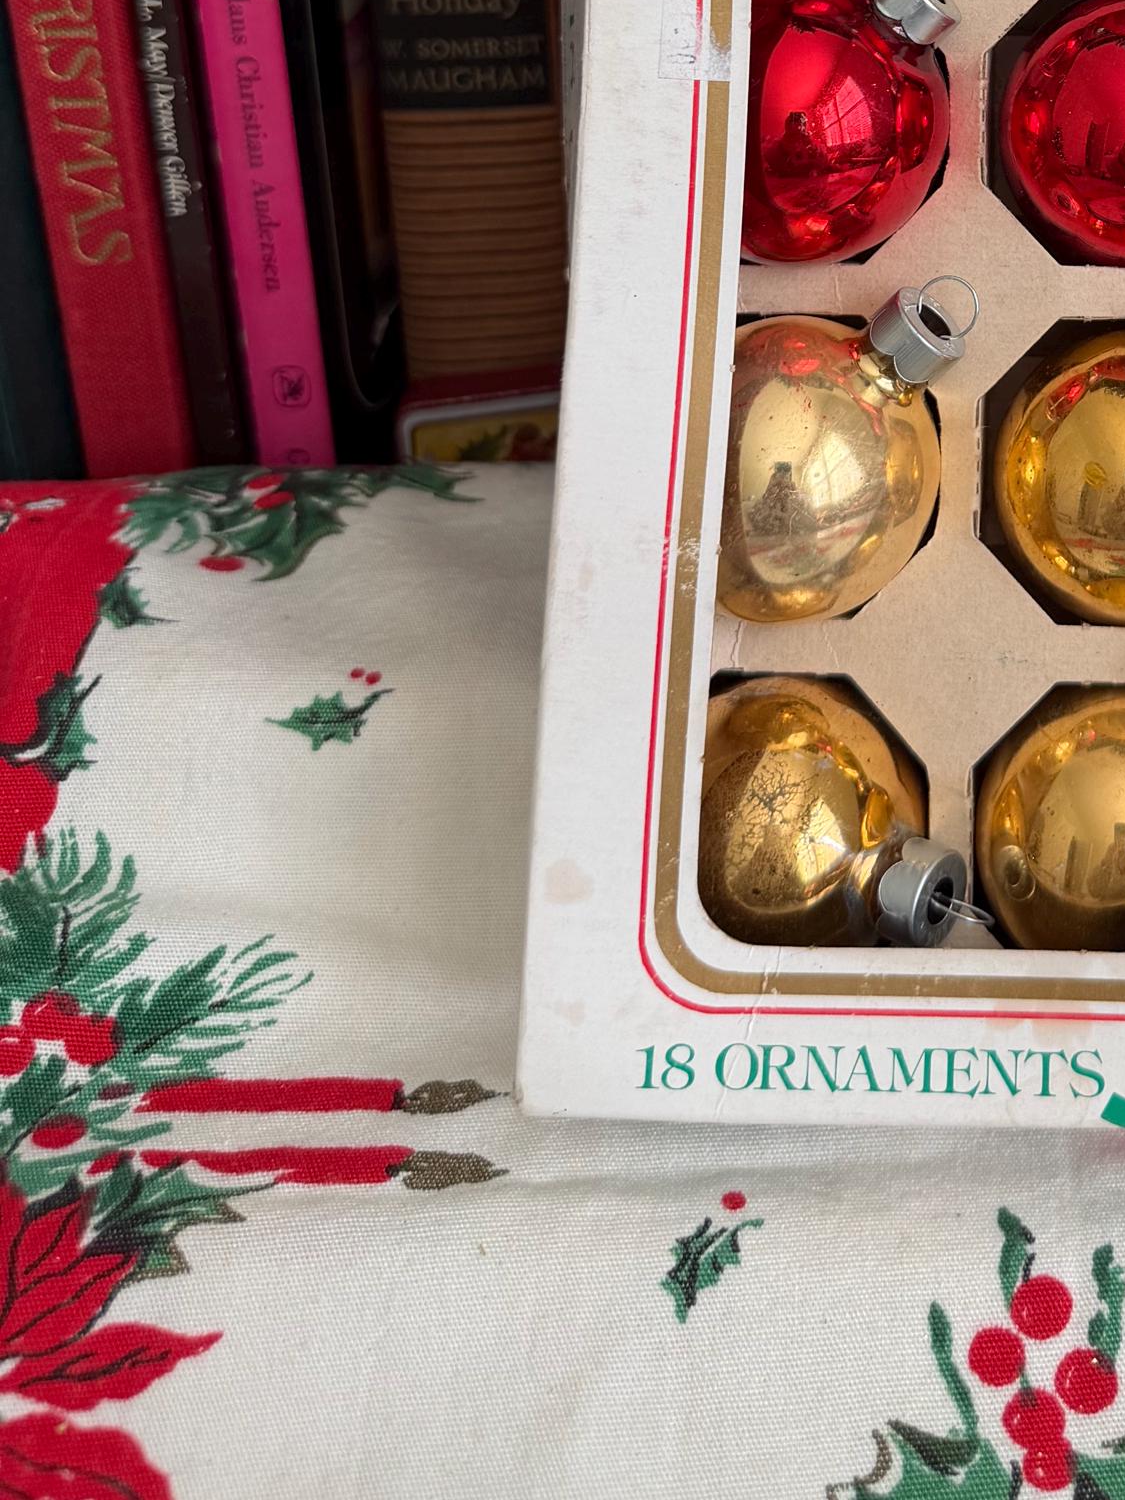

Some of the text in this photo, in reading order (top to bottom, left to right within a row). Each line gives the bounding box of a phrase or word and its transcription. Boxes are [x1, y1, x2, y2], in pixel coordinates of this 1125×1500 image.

[415, 34, 544, 61] SOMERSET
[383, 64, 545, 93] MAUGHAM
[160, 155, 192, 218] Gillen
[235, 55, 269, 169] Christian
[252, 178, 281, 294] Andersen
[634, 1041, 1107, 1100] 18 ORNAMENTS
